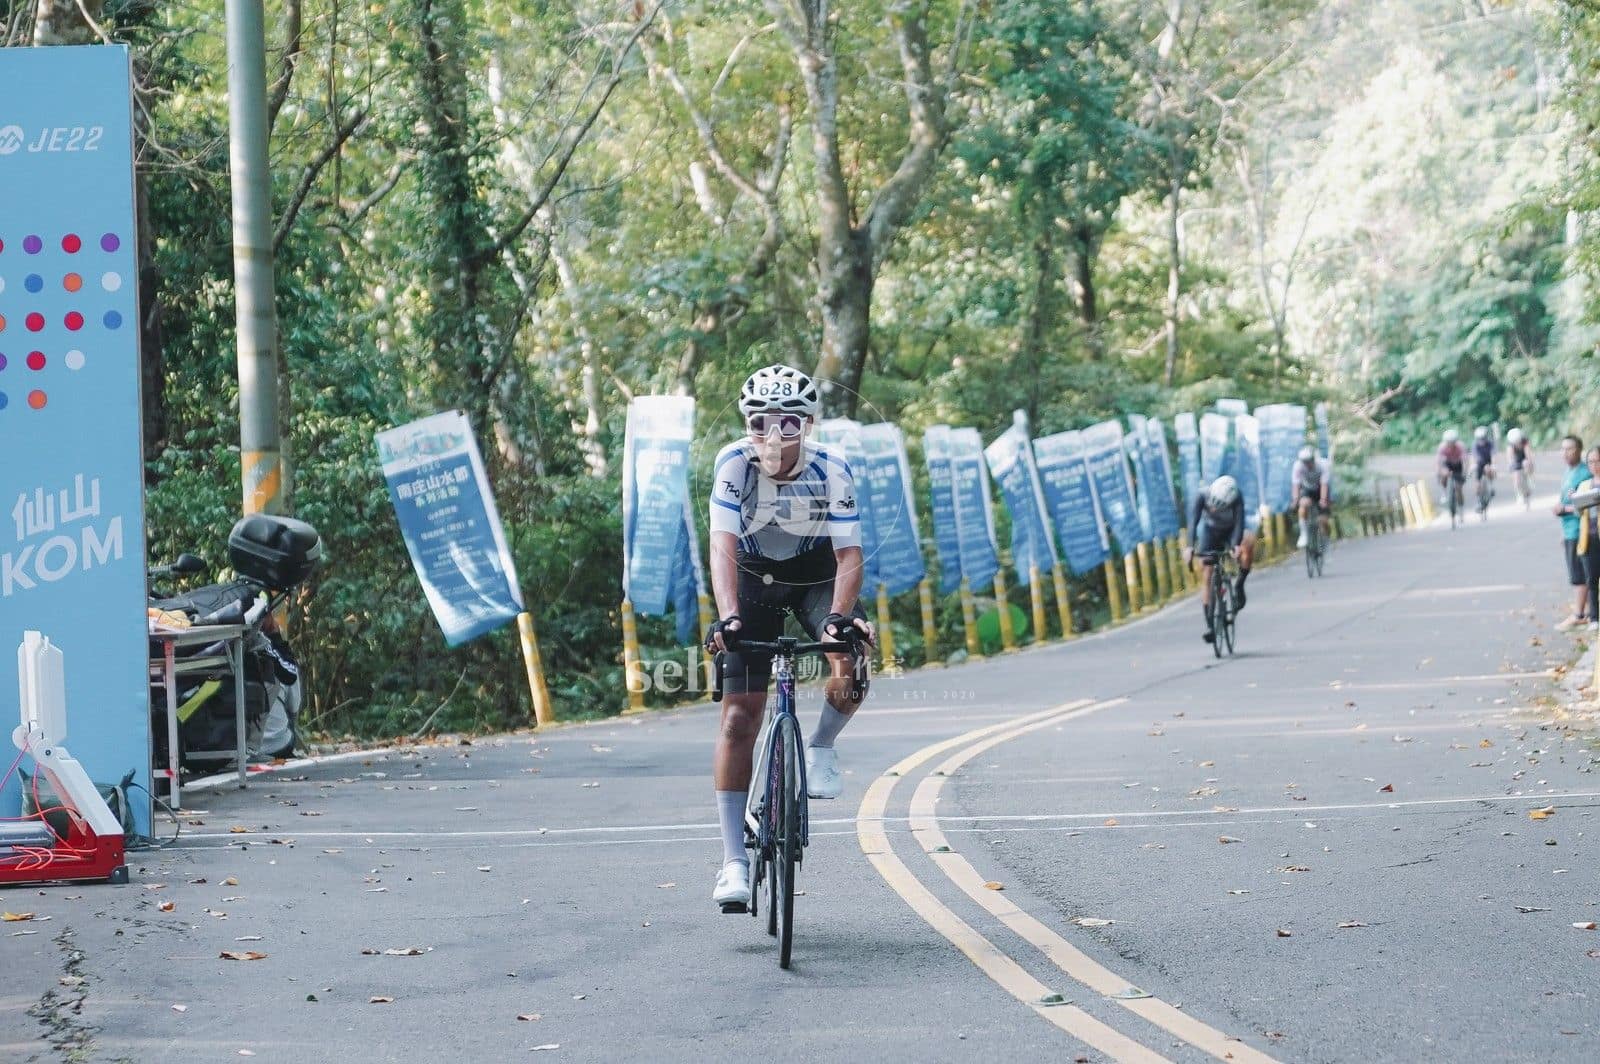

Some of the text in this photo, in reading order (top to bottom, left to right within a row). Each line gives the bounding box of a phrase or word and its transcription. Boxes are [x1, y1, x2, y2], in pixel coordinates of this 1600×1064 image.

[27, 125, 104, 153] JE22
[760, 382, 792, 396] 628
[1, 515, 124, 597] KOM
